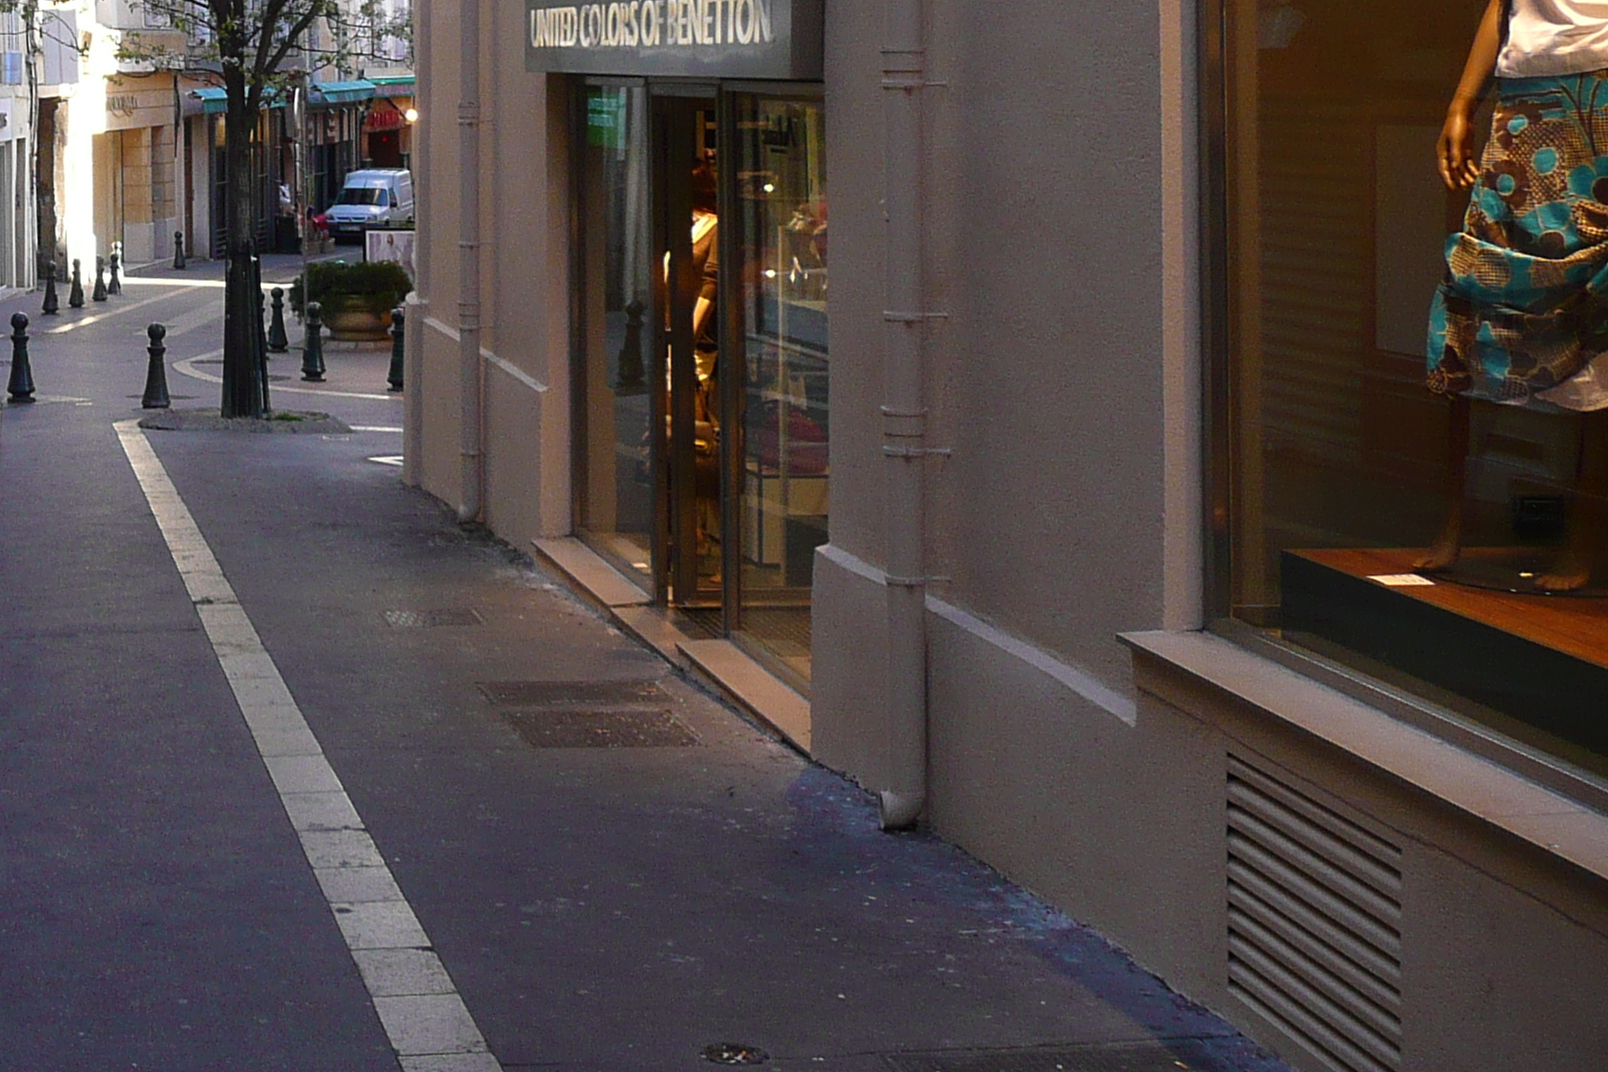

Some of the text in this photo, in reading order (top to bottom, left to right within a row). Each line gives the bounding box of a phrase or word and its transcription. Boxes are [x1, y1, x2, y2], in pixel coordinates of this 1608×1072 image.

[530, 7, 577, 48] UNITED
[579, 0, 639, 48] COLORS
[640, 0, 664, 46] OF
